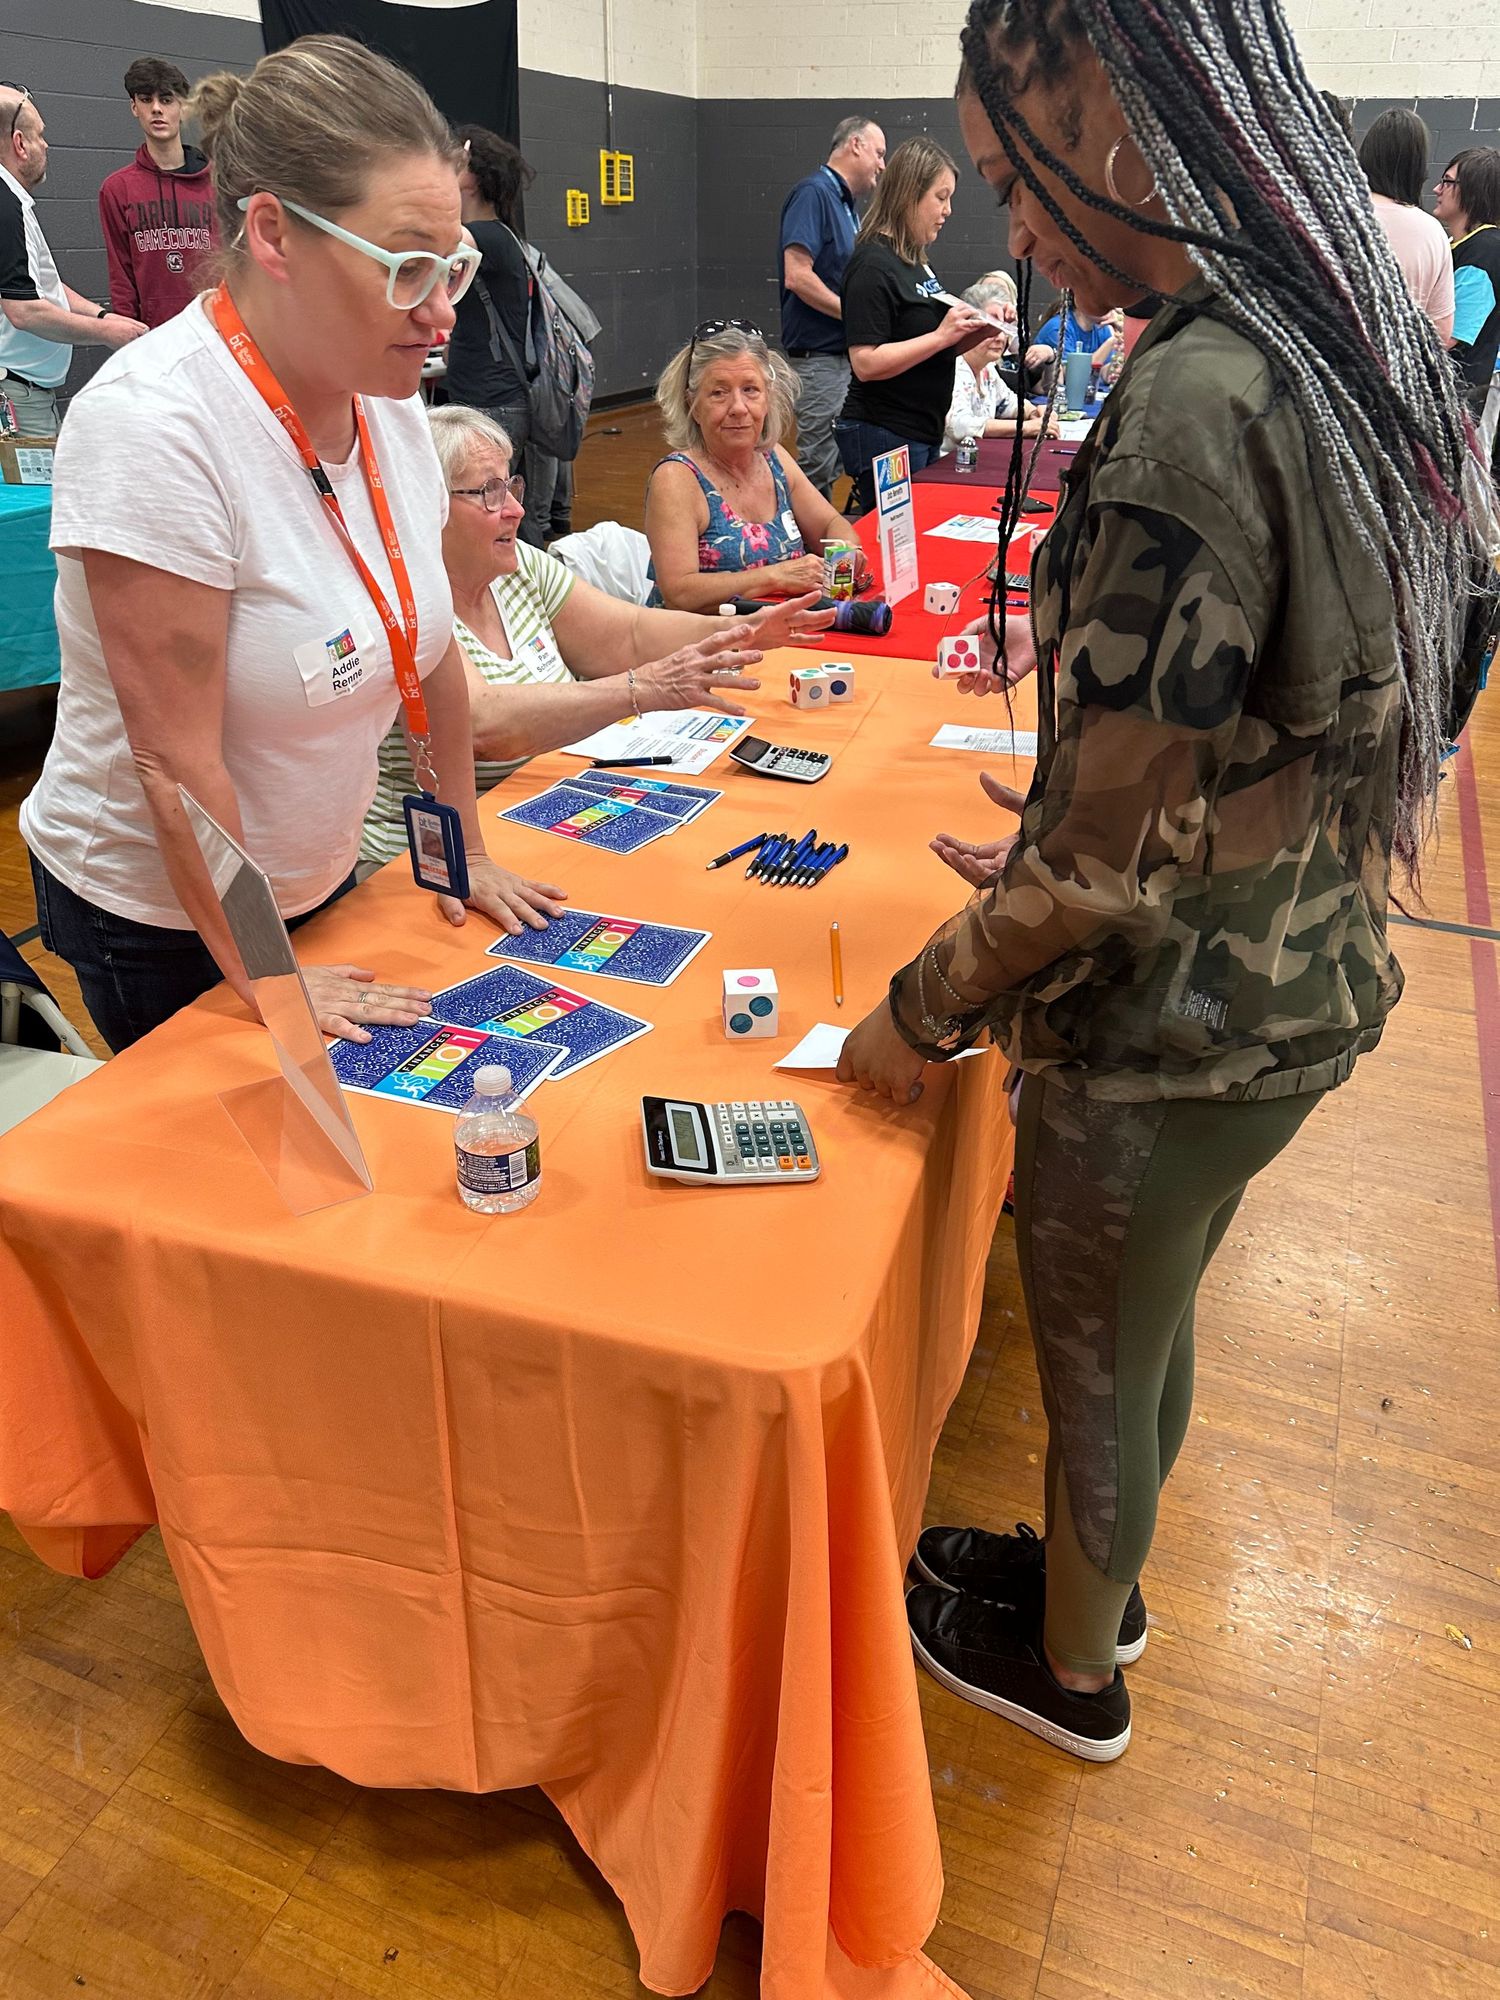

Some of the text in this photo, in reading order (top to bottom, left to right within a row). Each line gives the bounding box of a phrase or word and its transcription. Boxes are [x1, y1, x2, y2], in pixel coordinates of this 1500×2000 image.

[134, 228, 211, 252] GAMECOCKS
[229, 334, 244, 350] bt
[337, 637, 353, 654] 101
[332, 657, 359, 678] Addie
[333, 668, 362, 690] Renne
[555, 811, 603, 832] 101
[575, 813, 614, 835] FINANCES
[574, 921, 609, 951] FINANCES
[589, 923, 636, 952] 101
[499, 992, 557, 1022] FINANCES
[511, 997, 580, 1028] 101
[403, 1032, 451, 1071] FINANCES
[420, 1034, 482, 1073] 101
